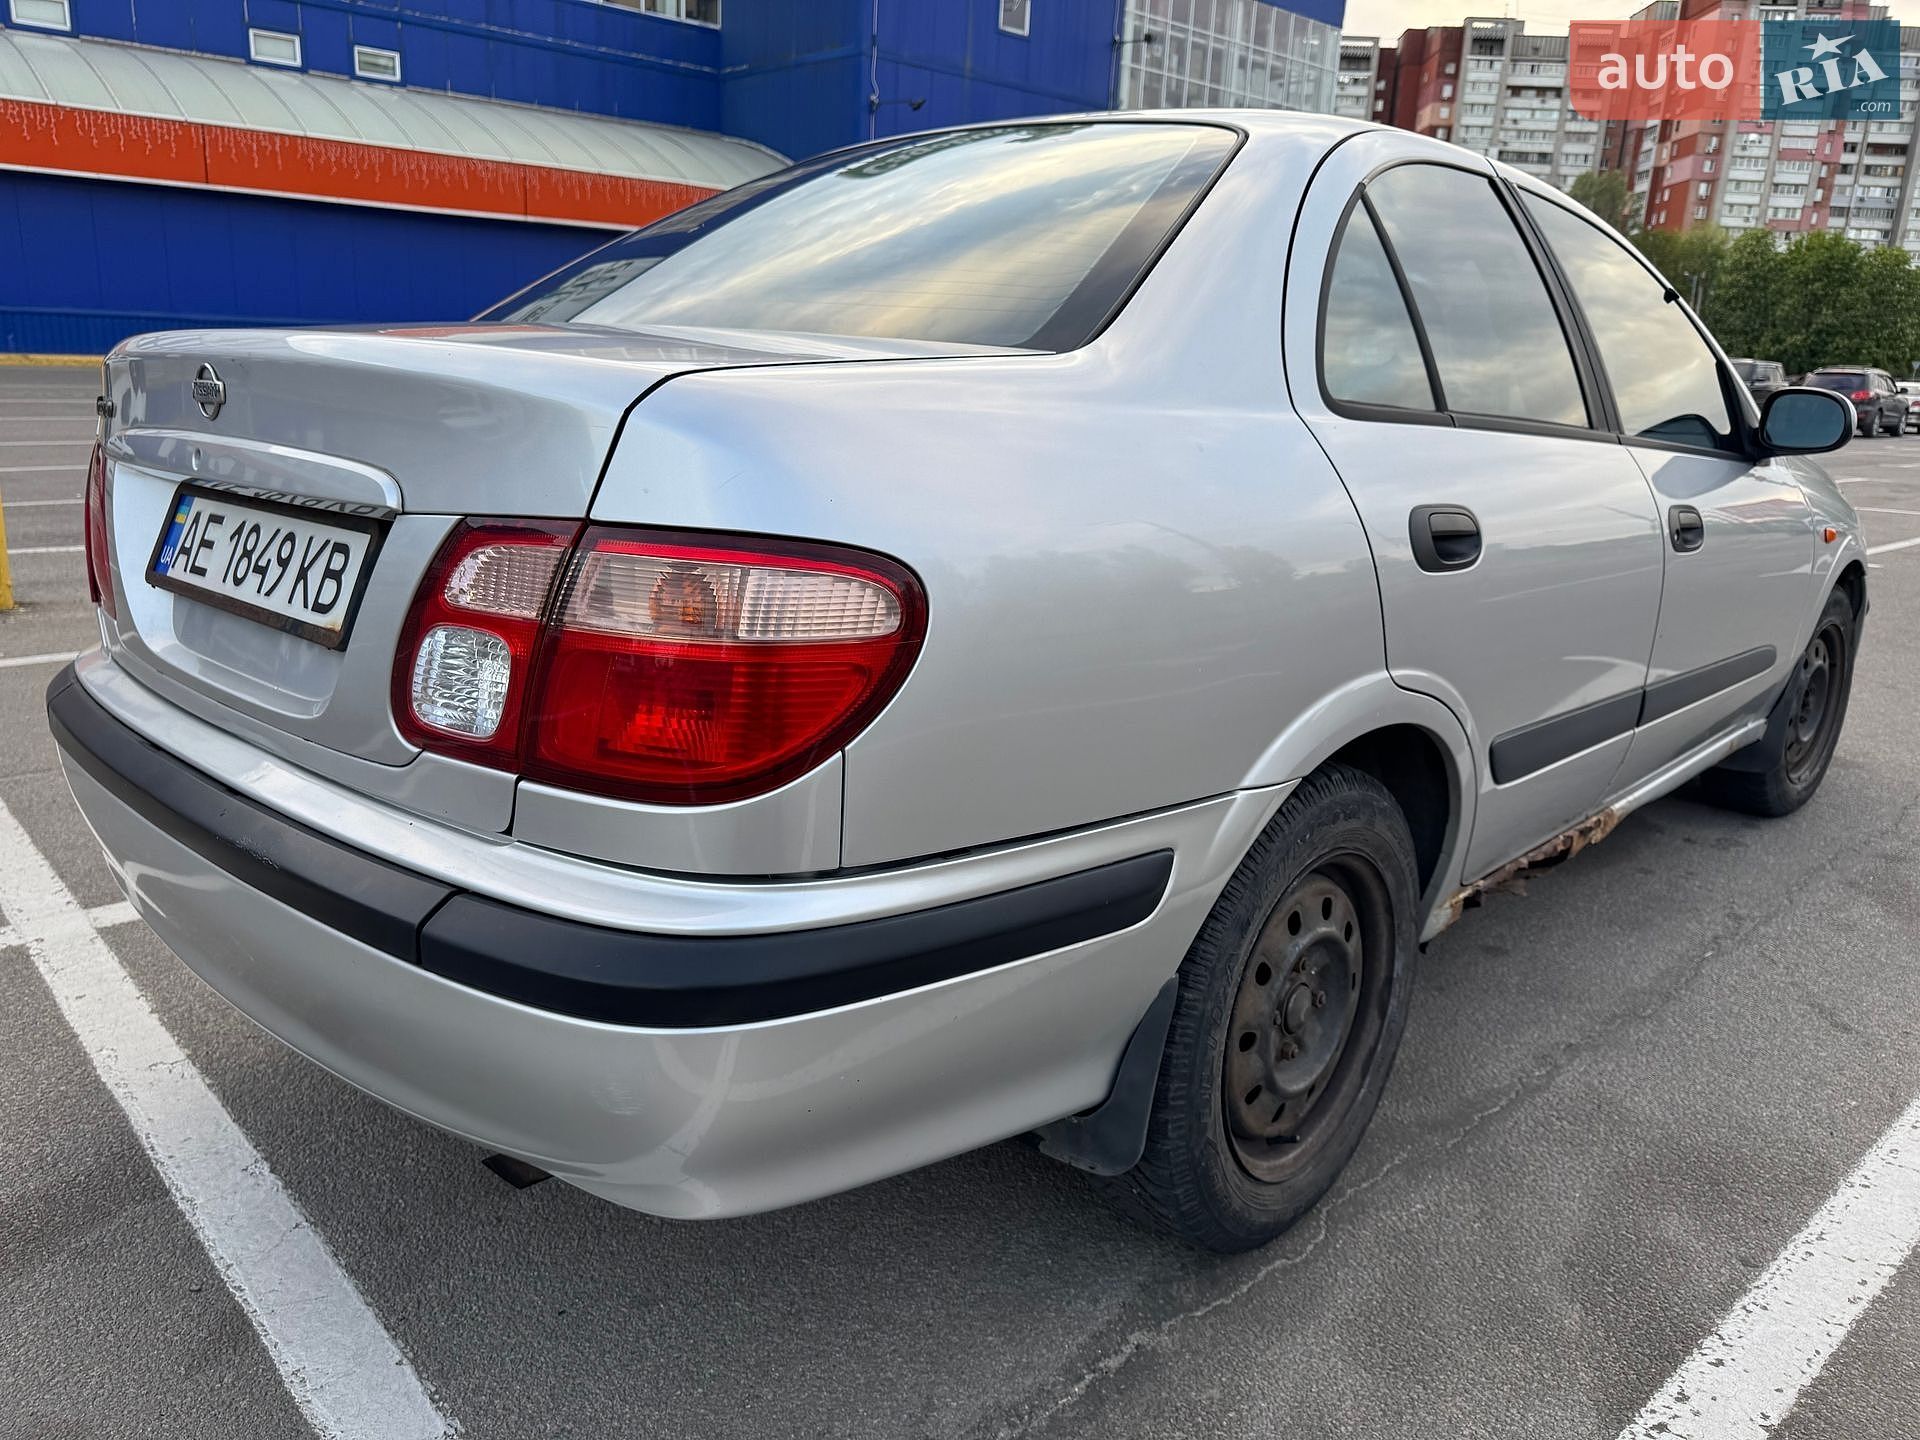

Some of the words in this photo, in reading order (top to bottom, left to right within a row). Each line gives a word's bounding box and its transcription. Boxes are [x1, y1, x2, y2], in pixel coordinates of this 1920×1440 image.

[160, 545, 174, 565] UA
[171, 511, 226, 578] AE
[222, 520, 297, 597] 1849
[287, 535, 351, 615] KB
